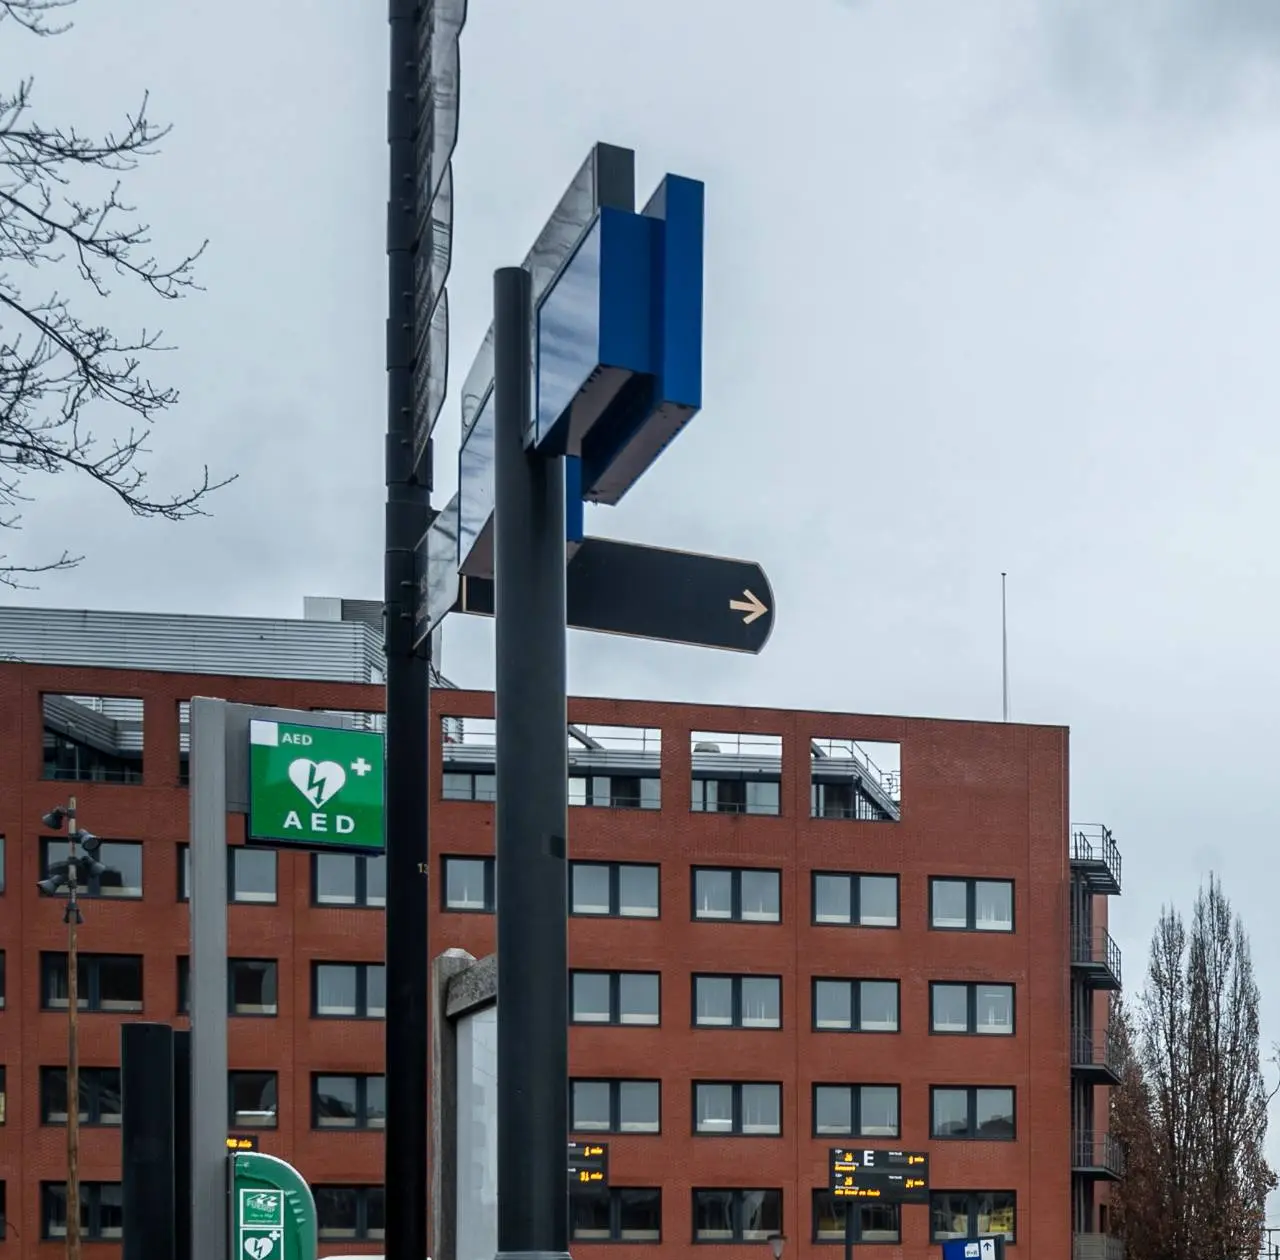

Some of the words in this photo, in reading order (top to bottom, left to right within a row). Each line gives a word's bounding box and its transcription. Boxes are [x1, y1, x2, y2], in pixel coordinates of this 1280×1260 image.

[282, 732, 313, 746] AED
[283, 810, 356, 834] AED
[863, 1150, 874, 1167] E
